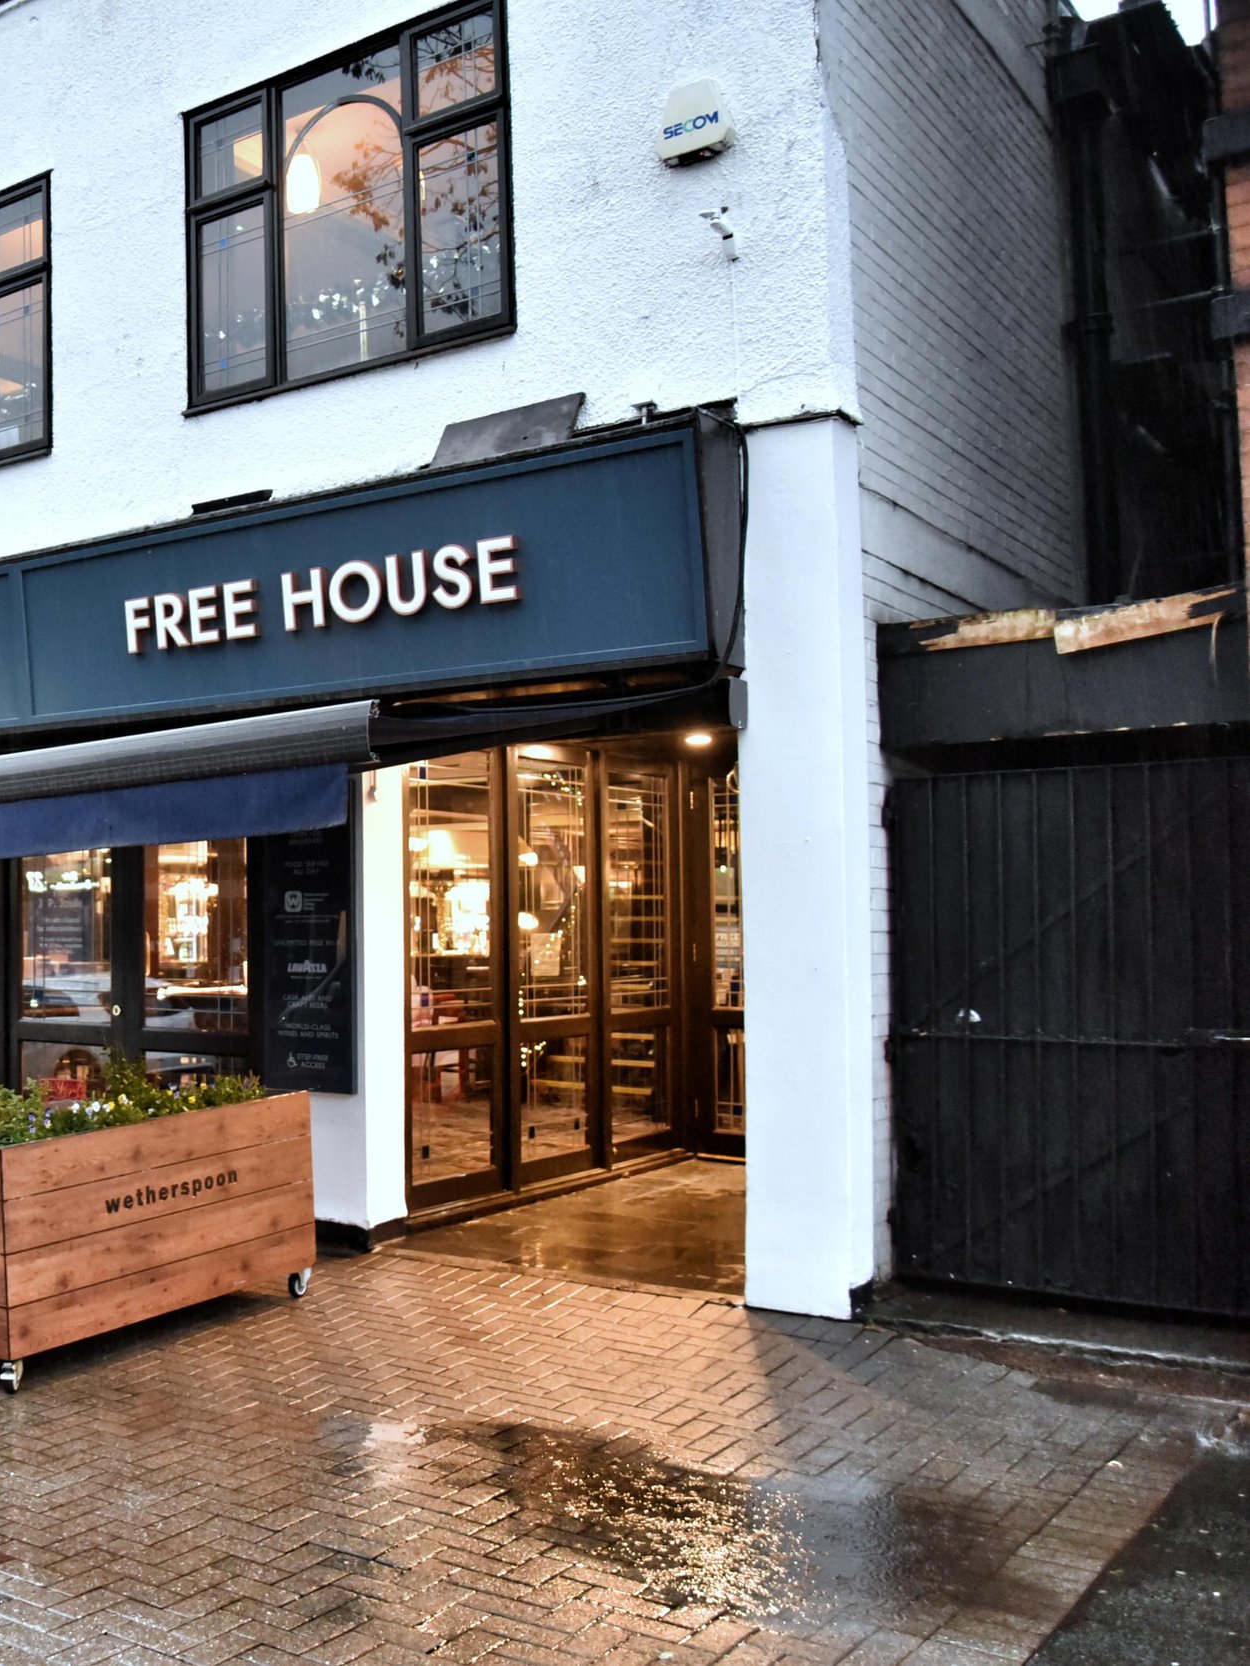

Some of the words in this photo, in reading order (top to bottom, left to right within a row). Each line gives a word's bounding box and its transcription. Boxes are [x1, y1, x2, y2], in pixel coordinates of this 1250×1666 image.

[663, 111, 718, 140] SECOM
[124, 578, 261, 653] FREE
[281, 535, 522, 632] HOUSE
[287, 959, 327, 973] LAVAZZA
[285, 1023, 331, 1032] WORLD-CLASS
[316, 1031, 338, 1039] SPIRITS
[297, 1053, 328, 1062] STEP-FREE
[105, 1169, 238, 1215] wetherspoon
